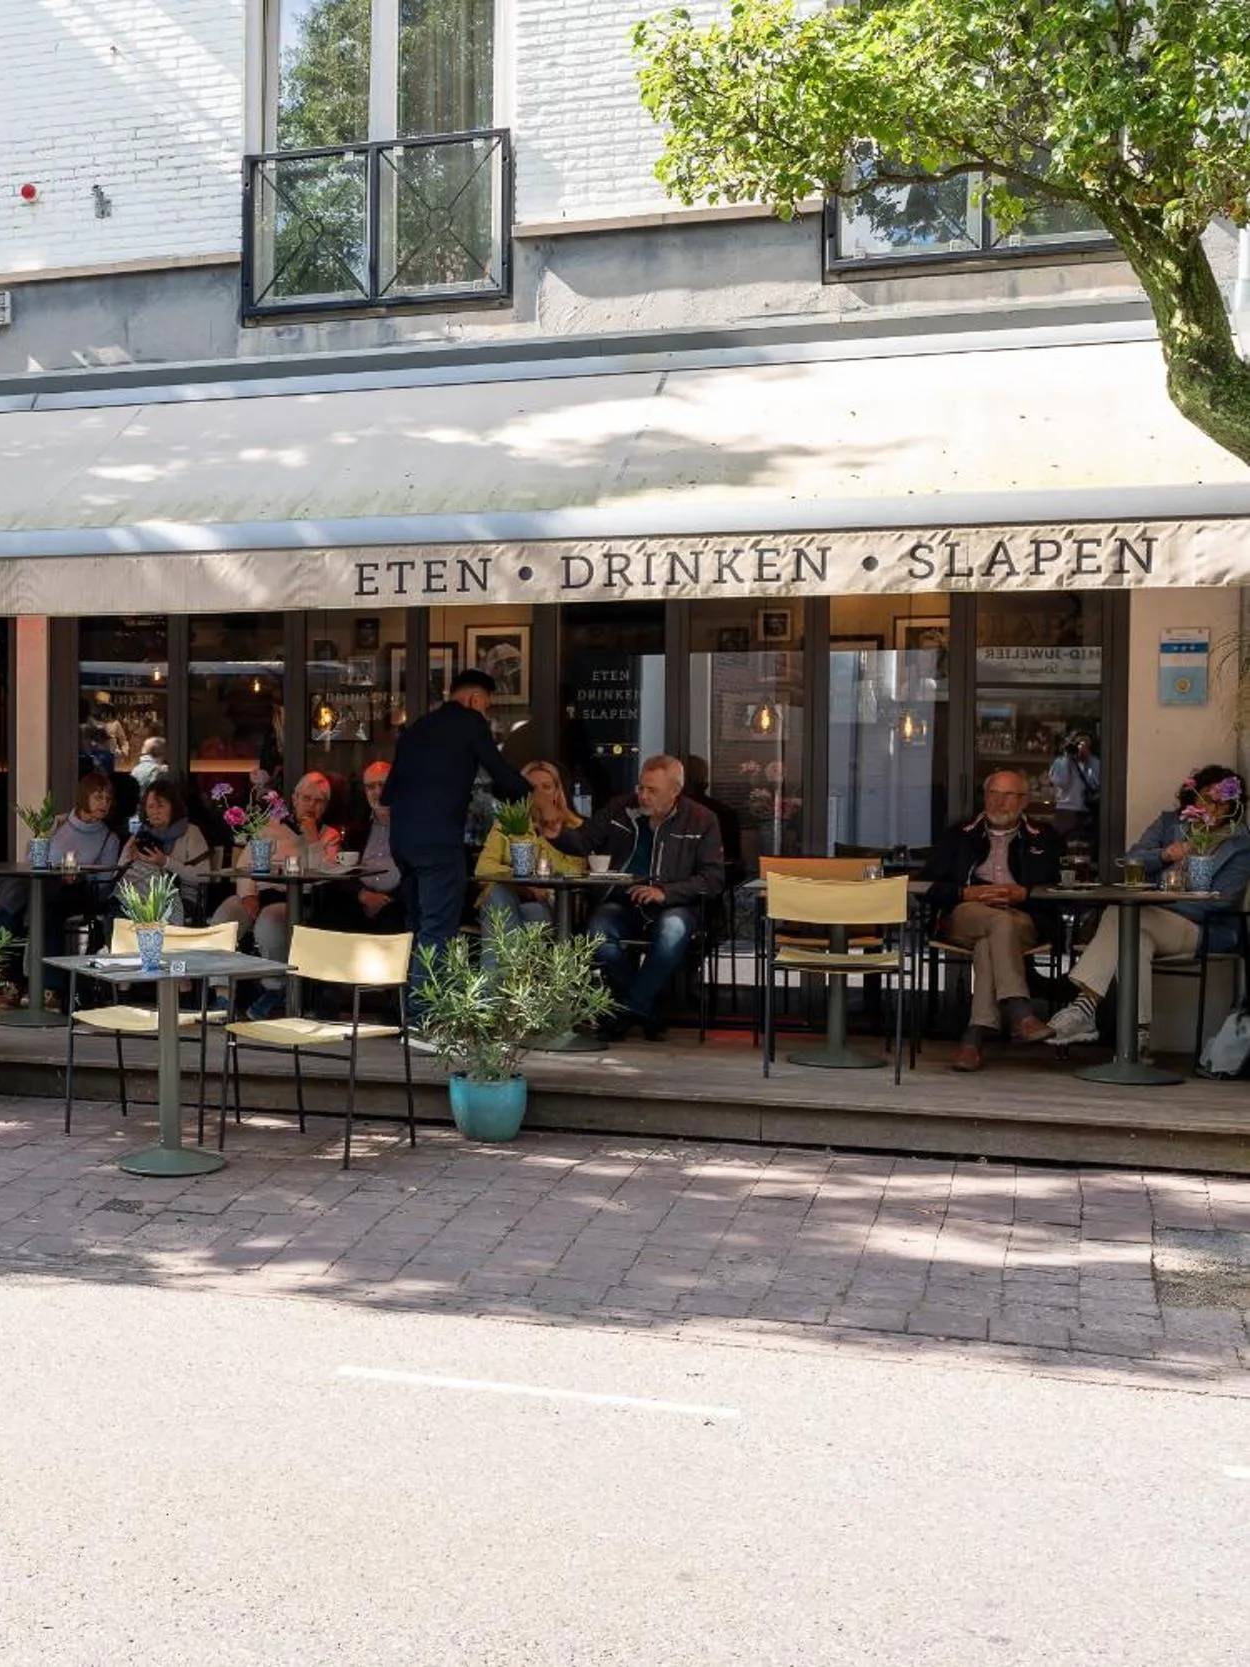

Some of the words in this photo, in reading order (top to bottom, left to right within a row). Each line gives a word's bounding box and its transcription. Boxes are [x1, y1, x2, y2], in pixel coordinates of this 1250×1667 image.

[354, 557, 492, 596] ETEN
[561, 546, 832, 590] DRINKEN
[907, 536, 1159, 579] SLAPEN
[592, 669, 631, 682] ETEN
[581, 707, 639, 720] SLAPEN
